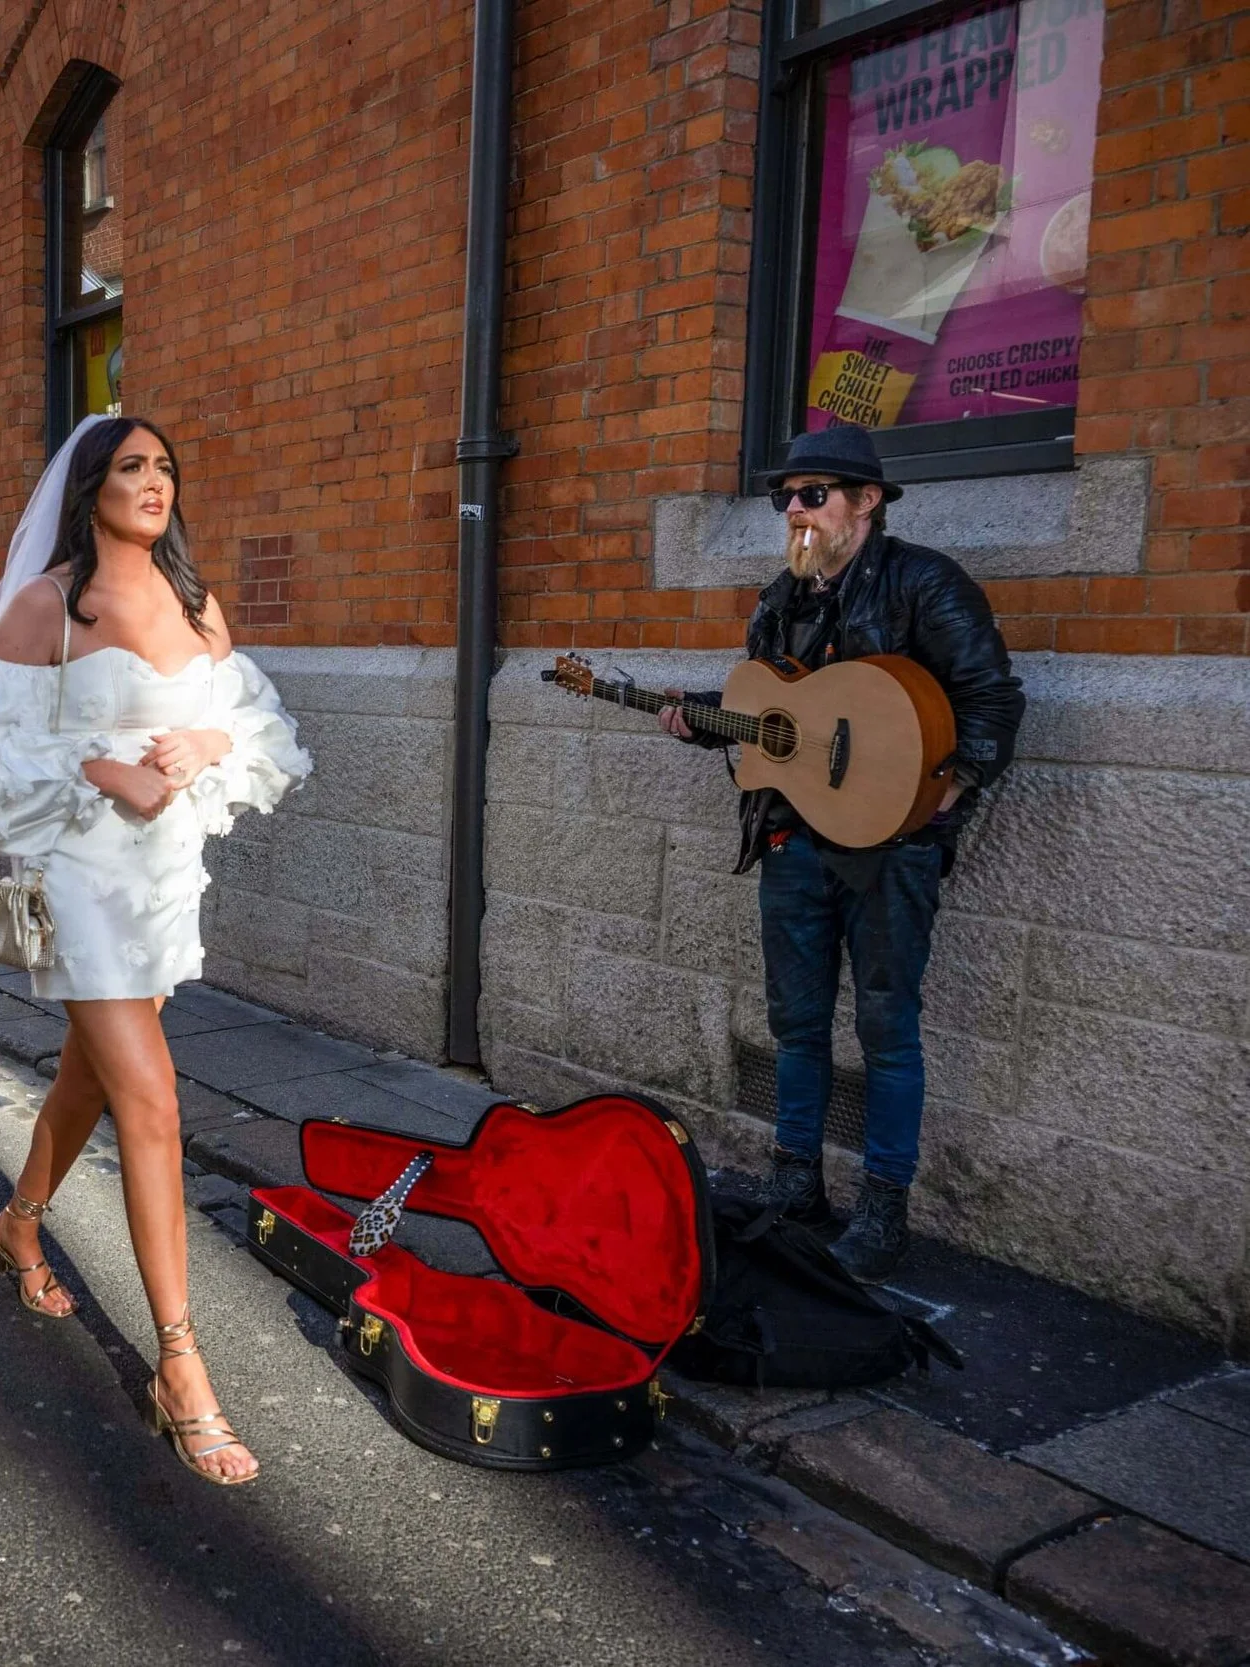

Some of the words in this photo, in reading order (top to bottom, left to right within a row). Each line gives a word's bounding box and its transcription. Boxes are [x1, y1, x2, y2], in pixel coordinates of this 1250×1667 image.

[875, 31, 1070, 136] WRAPPED
[862, 335, 893, 361] THE
[947, 351, 1004, 374] CHOOSE
[1007, 336, 1076, 366] CRISPY
[842, 352, 893, 384] SWEET
[950, 368, 1022, 397] GRILLED
[834, 373, 882, 405] CHILLI
[817, 389, 883, 427] CHICKEN
